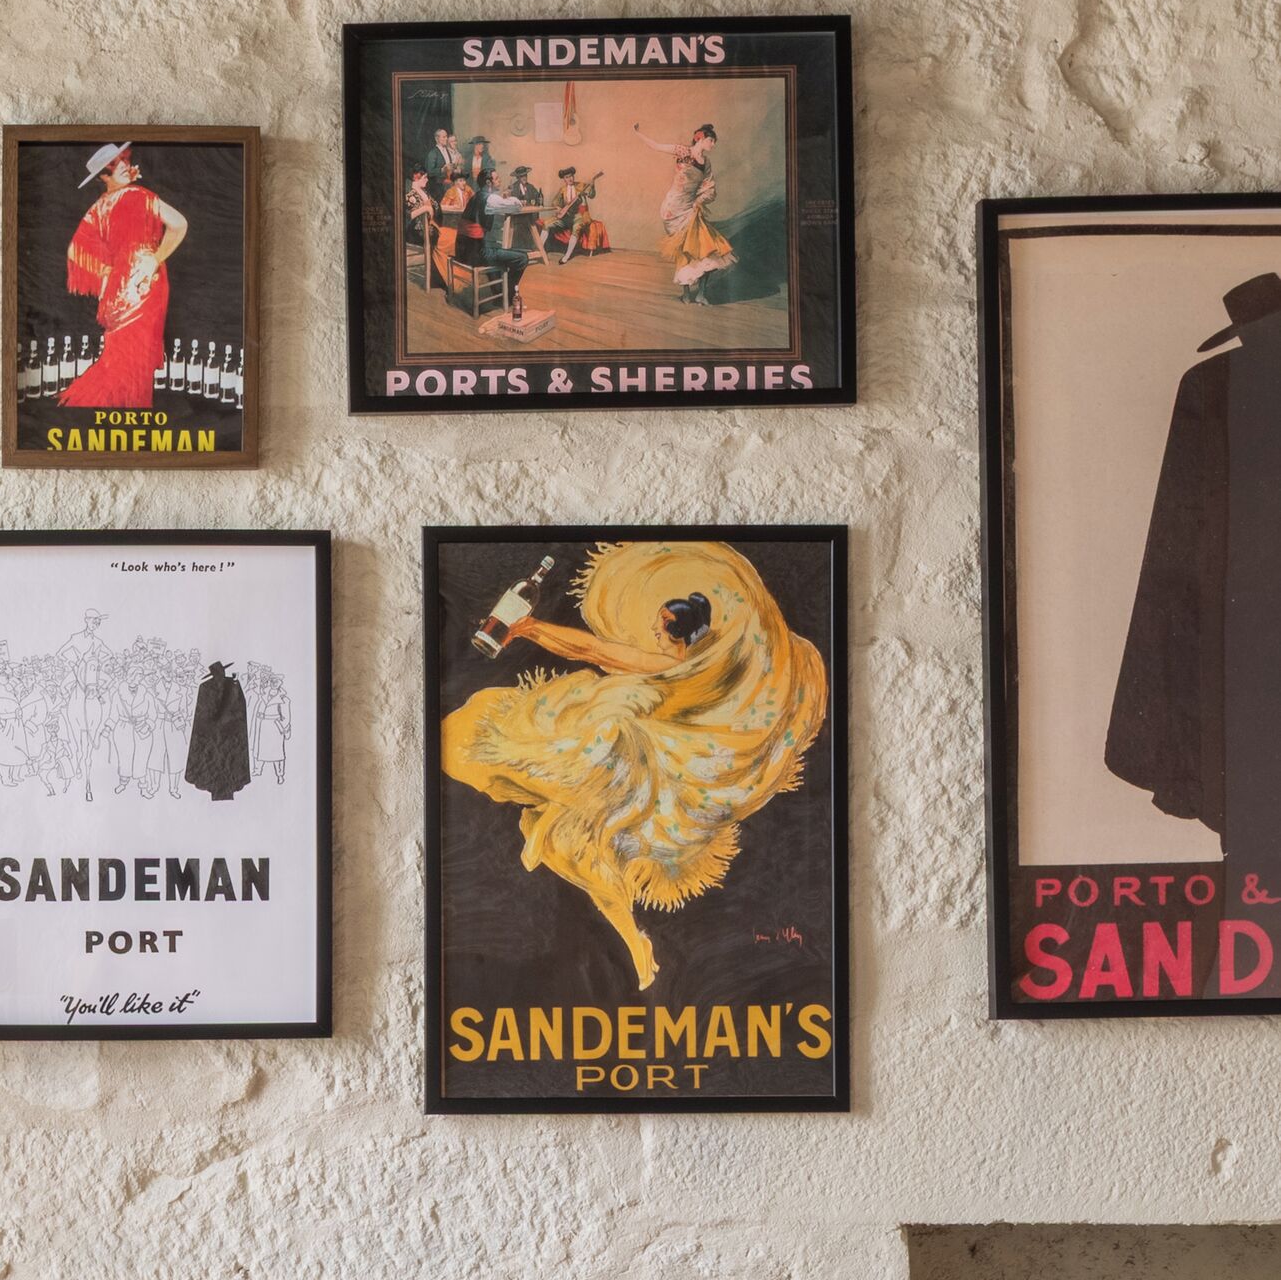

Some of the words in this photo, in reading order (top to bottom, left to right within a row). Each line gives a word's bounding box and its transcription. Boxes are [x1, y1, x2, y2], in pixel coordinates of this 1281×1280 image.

[462, 34, 726, 69] SANDEMAN'S
[385, 368, 530, 397] PORTS
[547, 367, 574, 394] &
[590, 364, 814, 394] SHERRIES
[94, 410, 168, 426] PORTO
[46, 427, 216, 452] SANDEMAN
[154, 561, 186, 572] who's
[1034, 873, 1216, 909] PORTO
[1240, 872, 1281, 906] &
[85, 929, 184, 955] PORT
[1018, 919, 1275, 1001] SAND
[119, 992, 164, 1015] like
[448, 1002, 832, 1063] SANDEMAN'S
[575, 1063, 710, 1092] PORT
